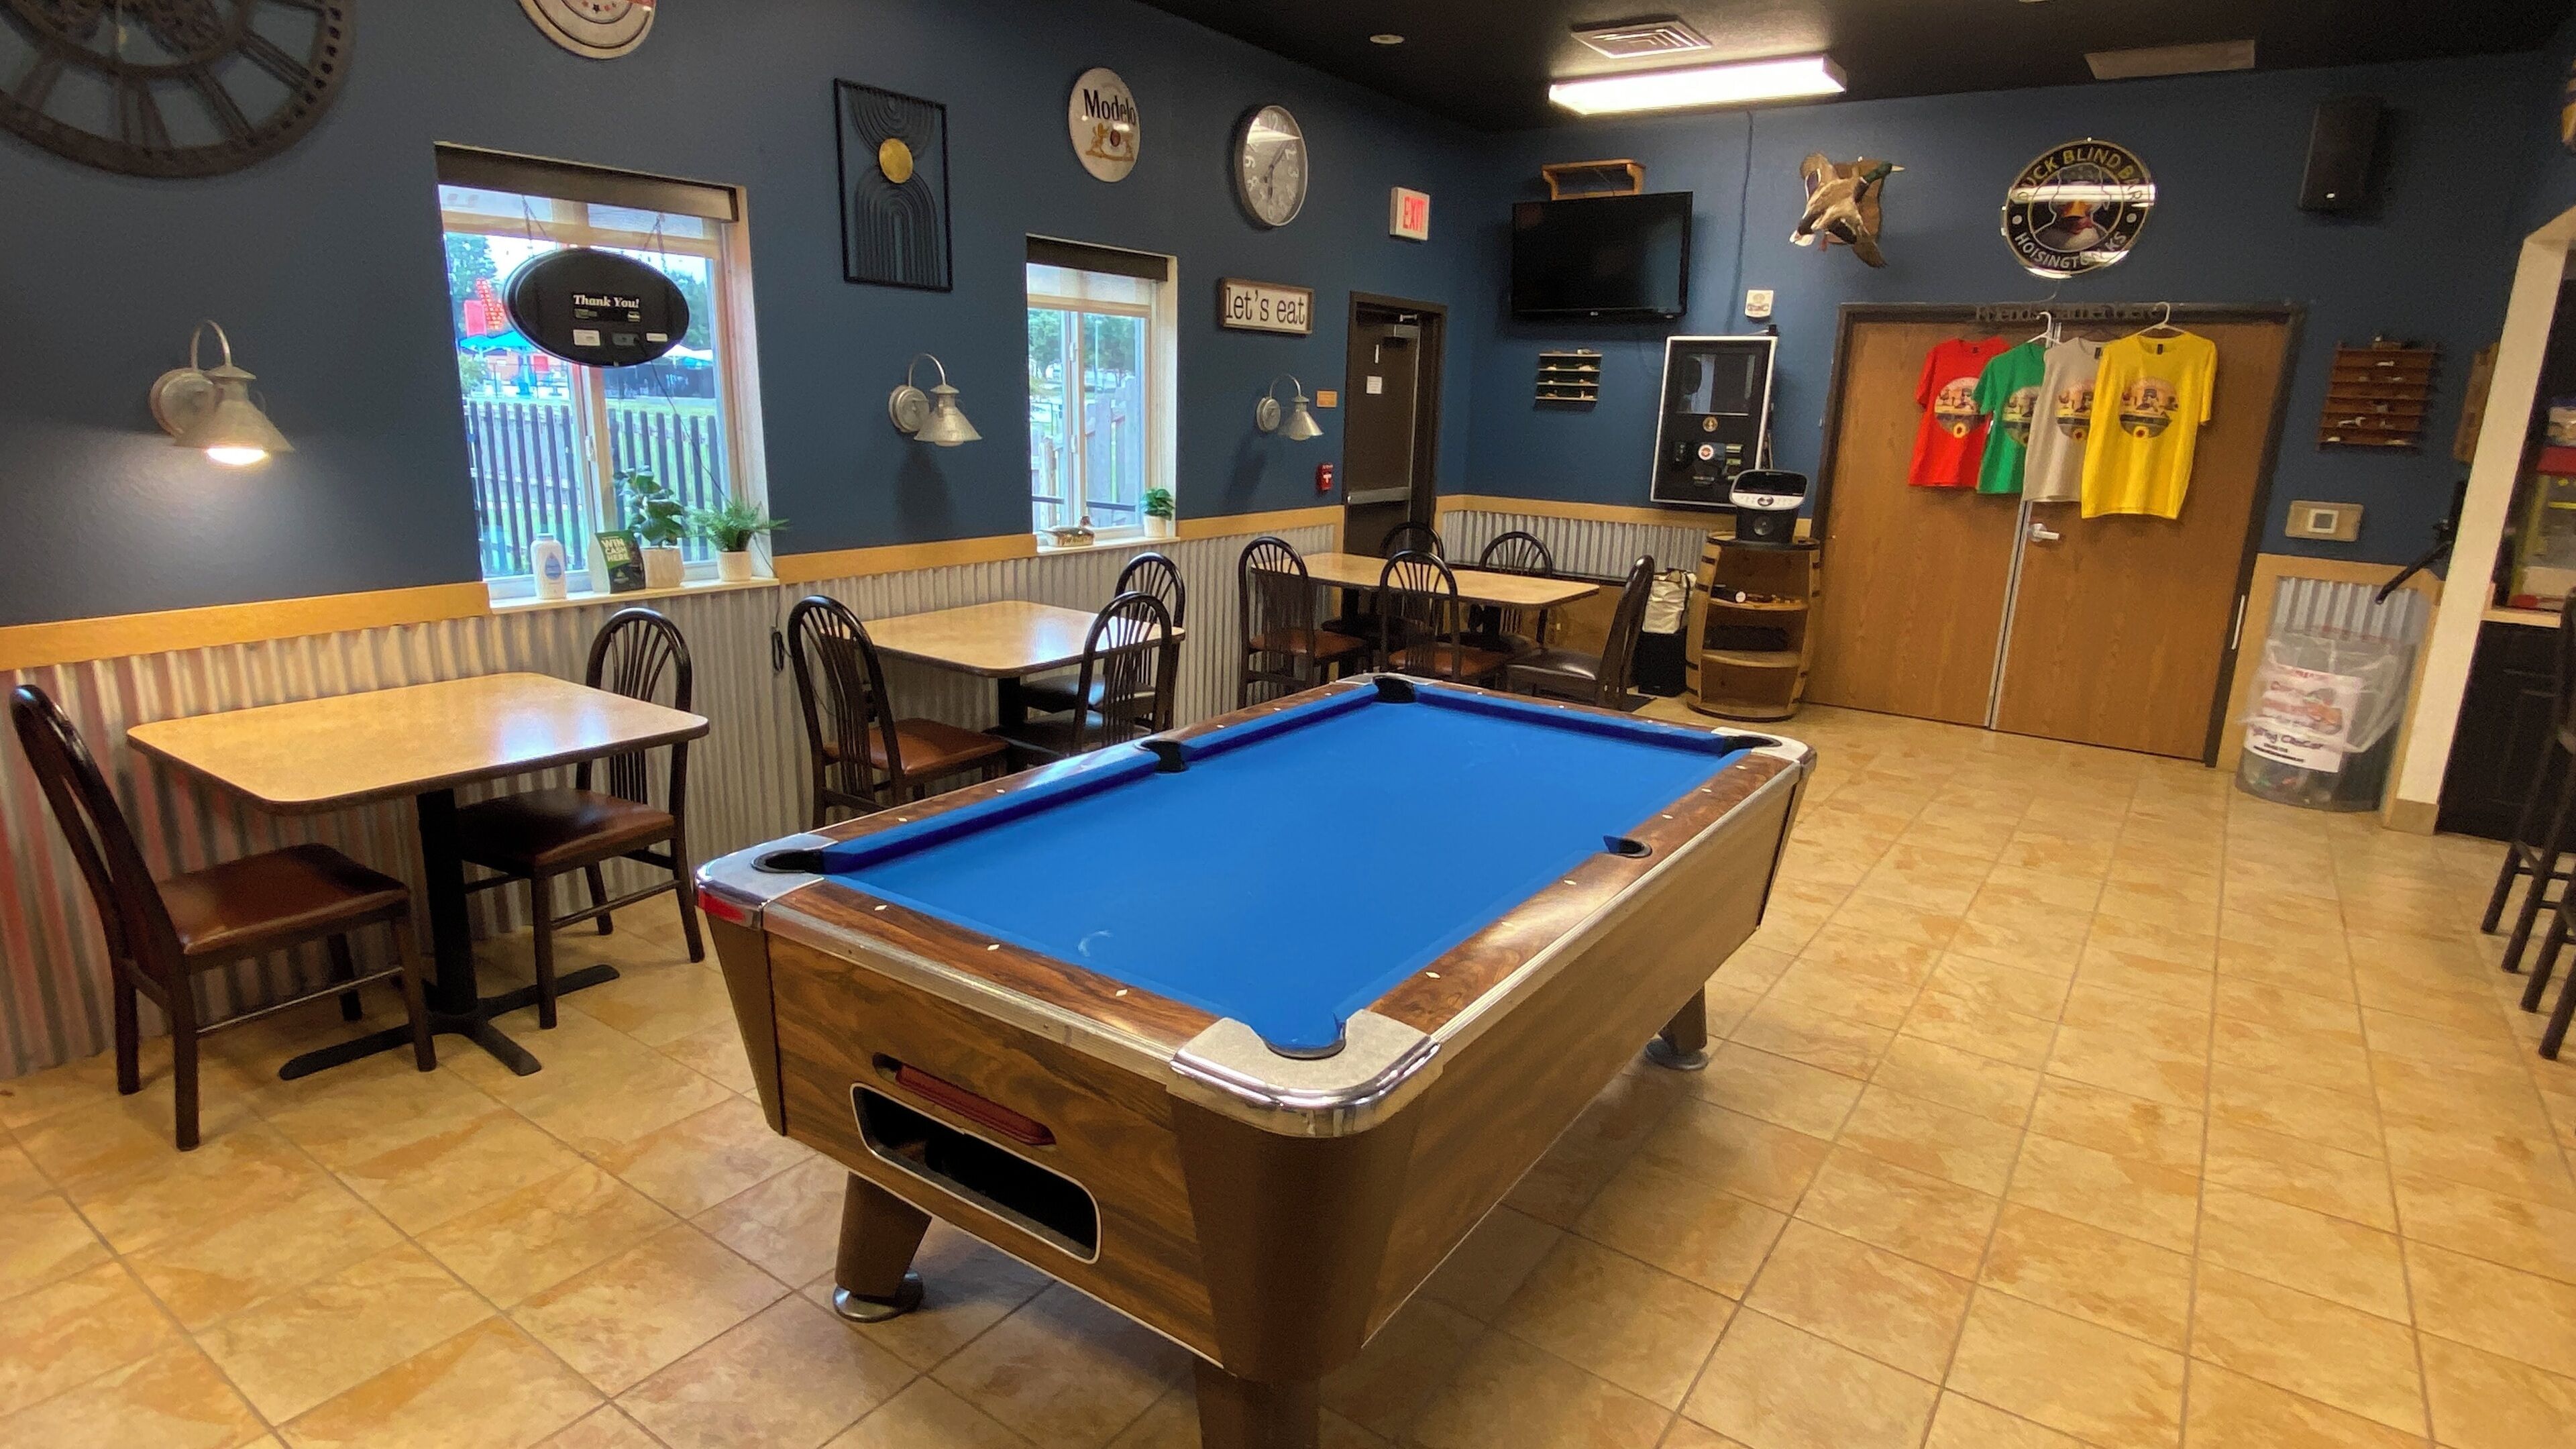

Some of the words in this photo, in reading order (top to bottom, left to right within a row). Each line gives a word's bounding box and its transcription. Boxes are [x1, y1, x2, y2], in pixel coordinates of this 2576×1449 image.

[1083, 89, 1136, 125] Modelo
[2017, 155, 2059, 202] DUCK
[2063, 146, 2121, 168] BLIND
[2117, 165, 2143, 200] BAR
[1403, 197, 1426, 231] EXIT
[2105, 231, 2127, 251] KS
[573, 294, 611, 307] Thank
[613, 297, 640, 309] You!
[1225, 286, 1269, 321] let's
[1277, 297, 1305, 325] eat
[601, 538, 625, 548] WIN
[604, 546, 628, 555] CASH
[606, 553, 631, 562] HERE
